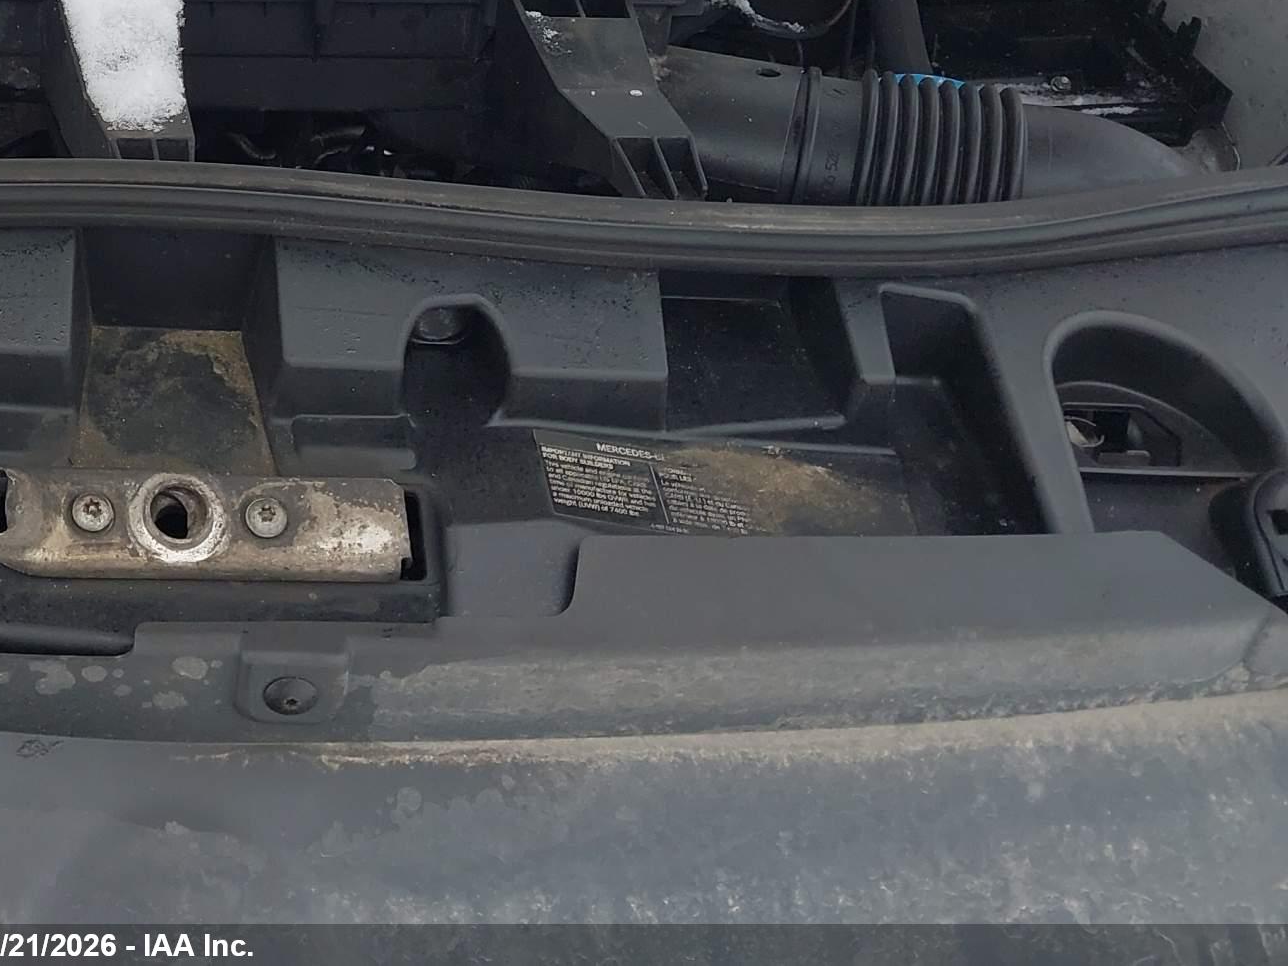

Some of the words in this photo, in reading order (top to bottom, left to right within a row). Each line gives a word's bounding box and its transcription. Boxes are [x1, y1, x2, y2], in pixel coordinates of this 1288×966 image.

[541, 446, 581, 458] IMPORTANT
[582, 453, 631, 466] INFORMATION
[542, 452, 558, 460] FOR
